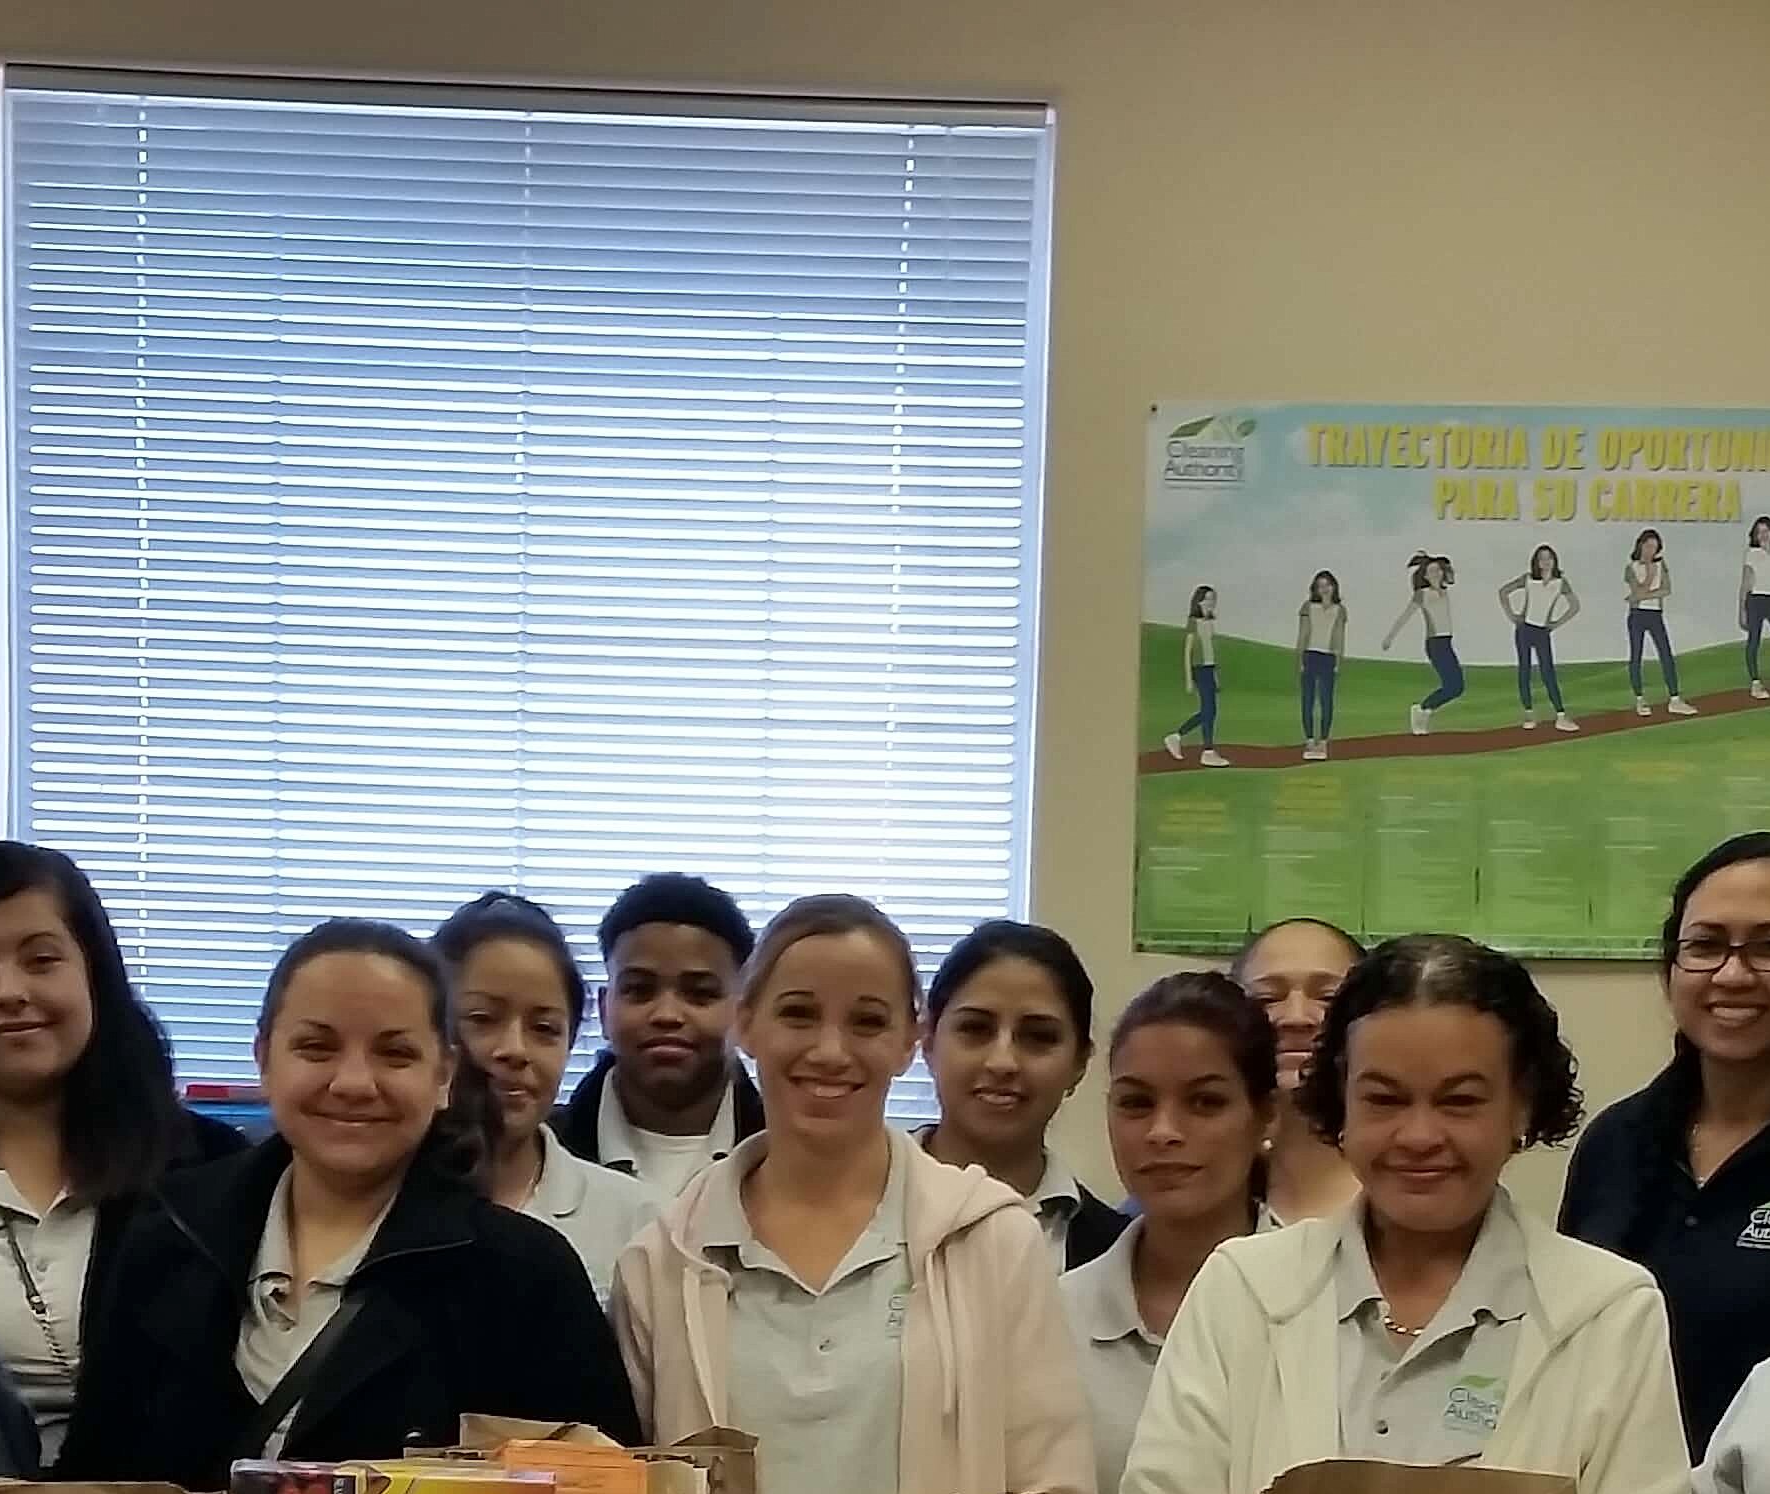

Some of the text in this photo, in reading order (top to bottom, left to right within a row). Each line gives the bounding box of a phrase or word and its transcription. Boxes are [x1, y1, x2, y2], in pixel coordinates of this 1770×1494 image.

[1308, 423, 1528, 471] TRAYECTORIA
[1541, 430, 1585, 471] DE
[1433, 476, 1744, 524] PARA SU CARRERA
